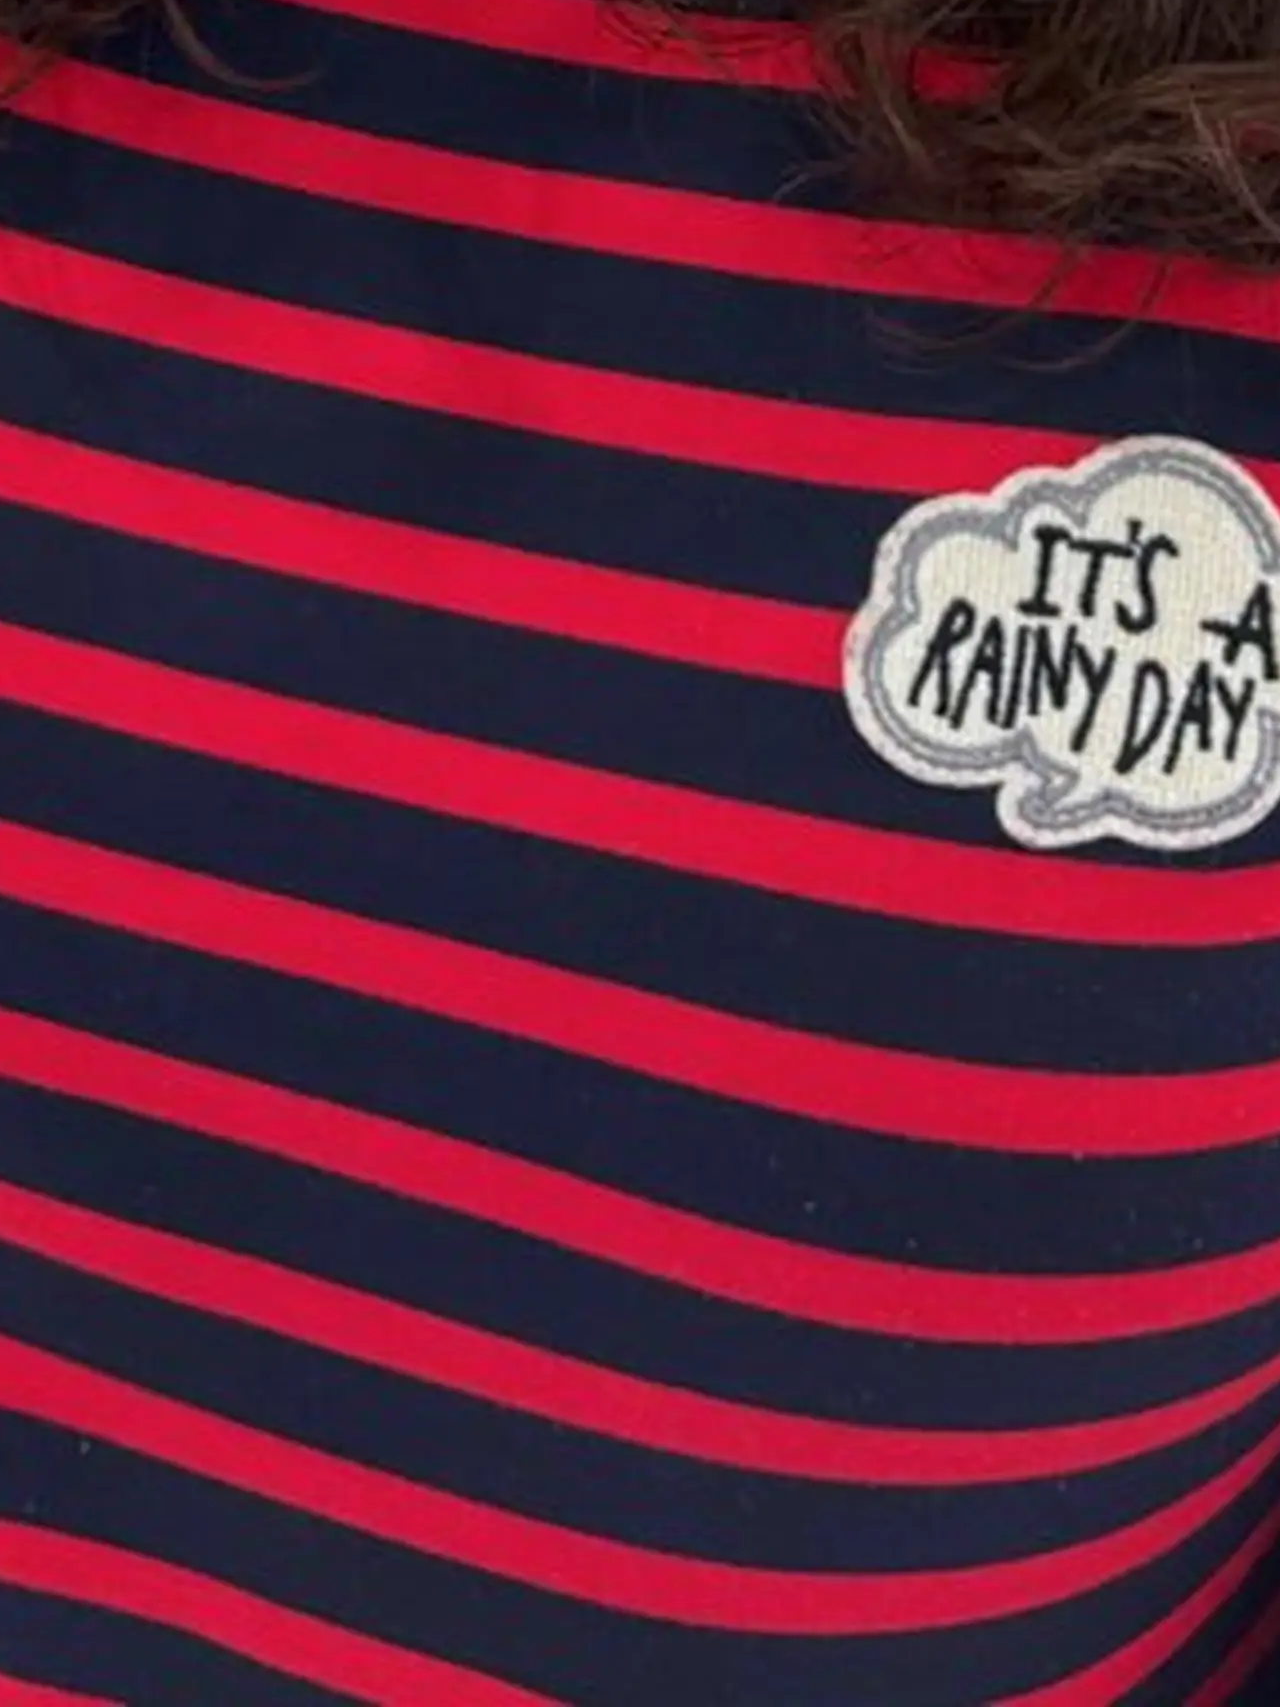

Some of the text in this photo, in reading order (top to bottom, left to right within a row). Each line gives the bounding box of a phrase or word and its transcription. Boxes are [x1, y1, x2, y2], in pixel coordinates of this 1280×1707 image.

[1015, 519, 1280, 681] IT'S A
[908, 597, 1256, 776] RAINY DAY
